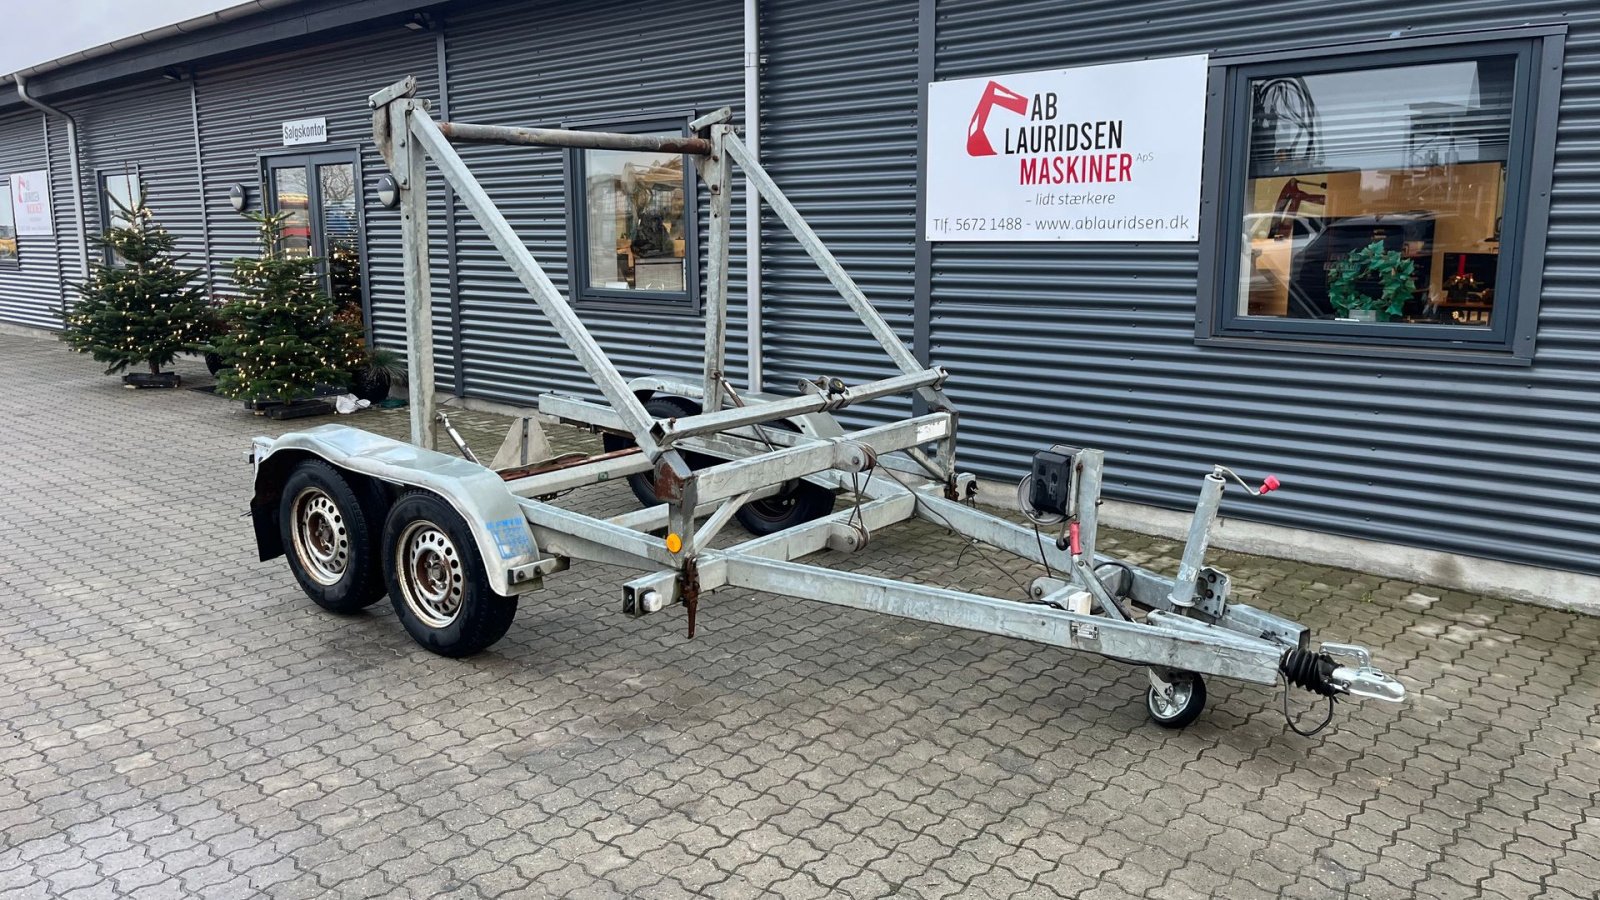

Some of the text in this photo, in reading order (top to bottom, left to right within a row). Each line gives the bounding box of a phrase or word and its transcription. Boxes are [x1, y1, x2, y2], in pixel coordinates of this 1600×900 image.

[1031, 92, 1058, 121] AB
[284, 123, 324, 142] Salgskontor
[1005, 120, 1123, 154] LAURIDSEN
[1020, 152, 1154, 185] MASKINER ApS
[1035, 192, 1055, 205] lidt
[1058, 190, 1115, 205] stærkere
[933, 218, 951, 233] Tlf.
[956, 217, 986, 231] 5672
[991, 217, 1022, 231] 1488
[1035, 215, 1189, 230] www.ablauridsen.dk
